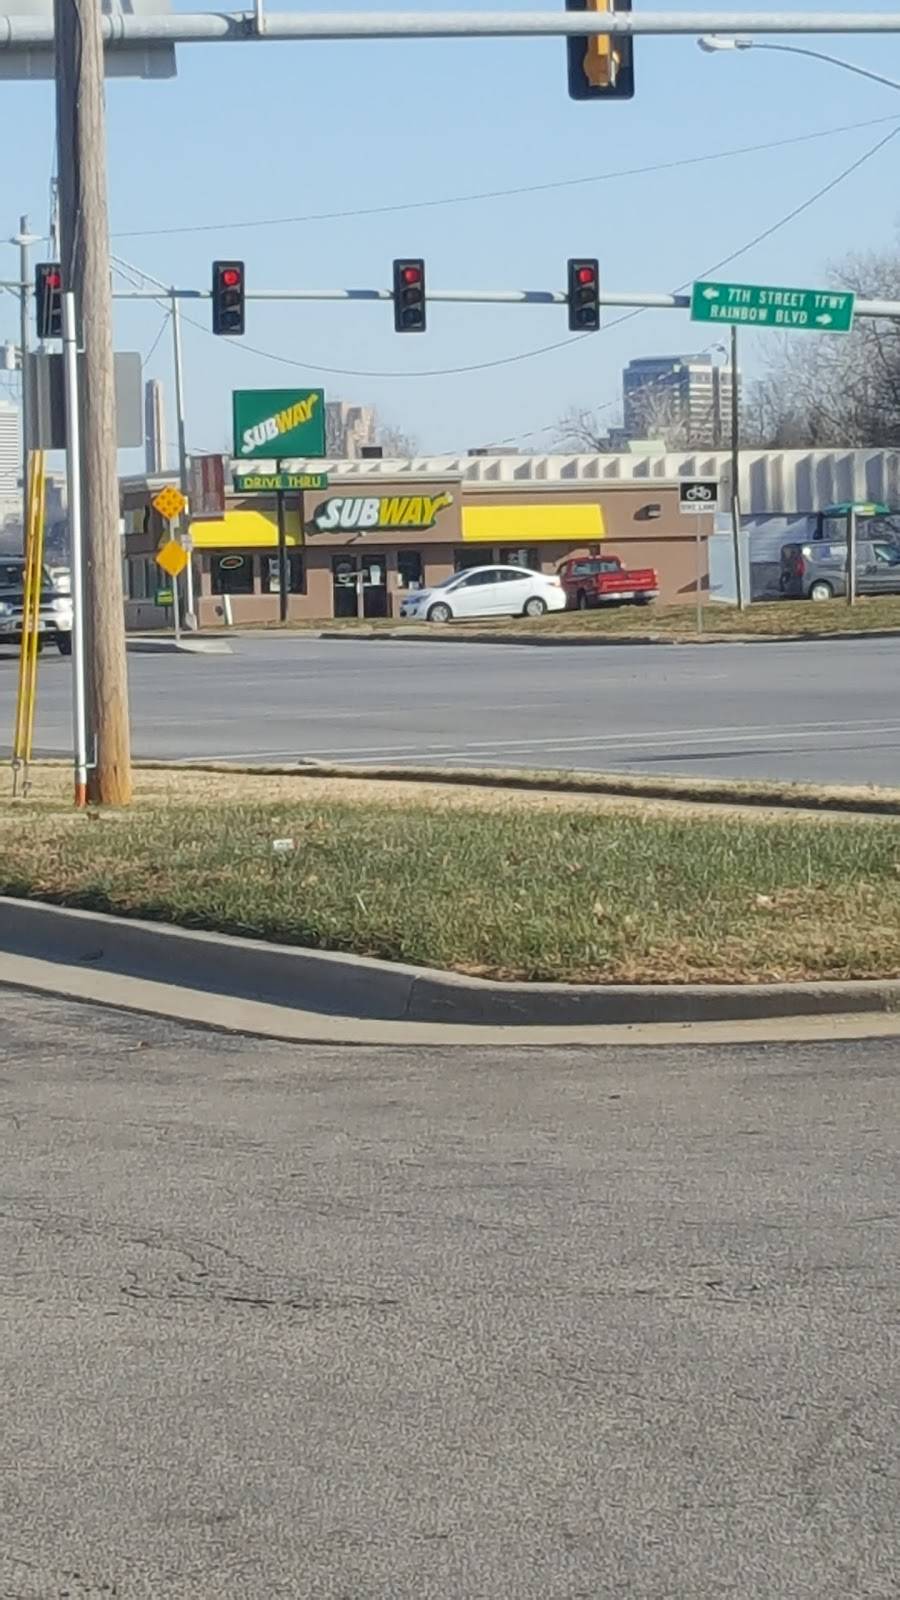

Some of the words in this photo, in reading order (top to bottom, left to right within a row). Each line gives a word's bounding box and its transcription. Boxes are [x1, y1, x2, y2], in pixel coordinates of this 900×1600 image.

[727, 288, 751, 303] 7TH
[759, 291, 807, 307] STREET
[710, 304, 768, 321] RAINBOW
[775, 310, 808, 324] BLVD
[241, 393, 319, 454] SUBWAY
[243, 476, 282, 489] DRIVE
[287, 475, 320, 488] THRU
[316, 491, 454, 529] SUBWAY
